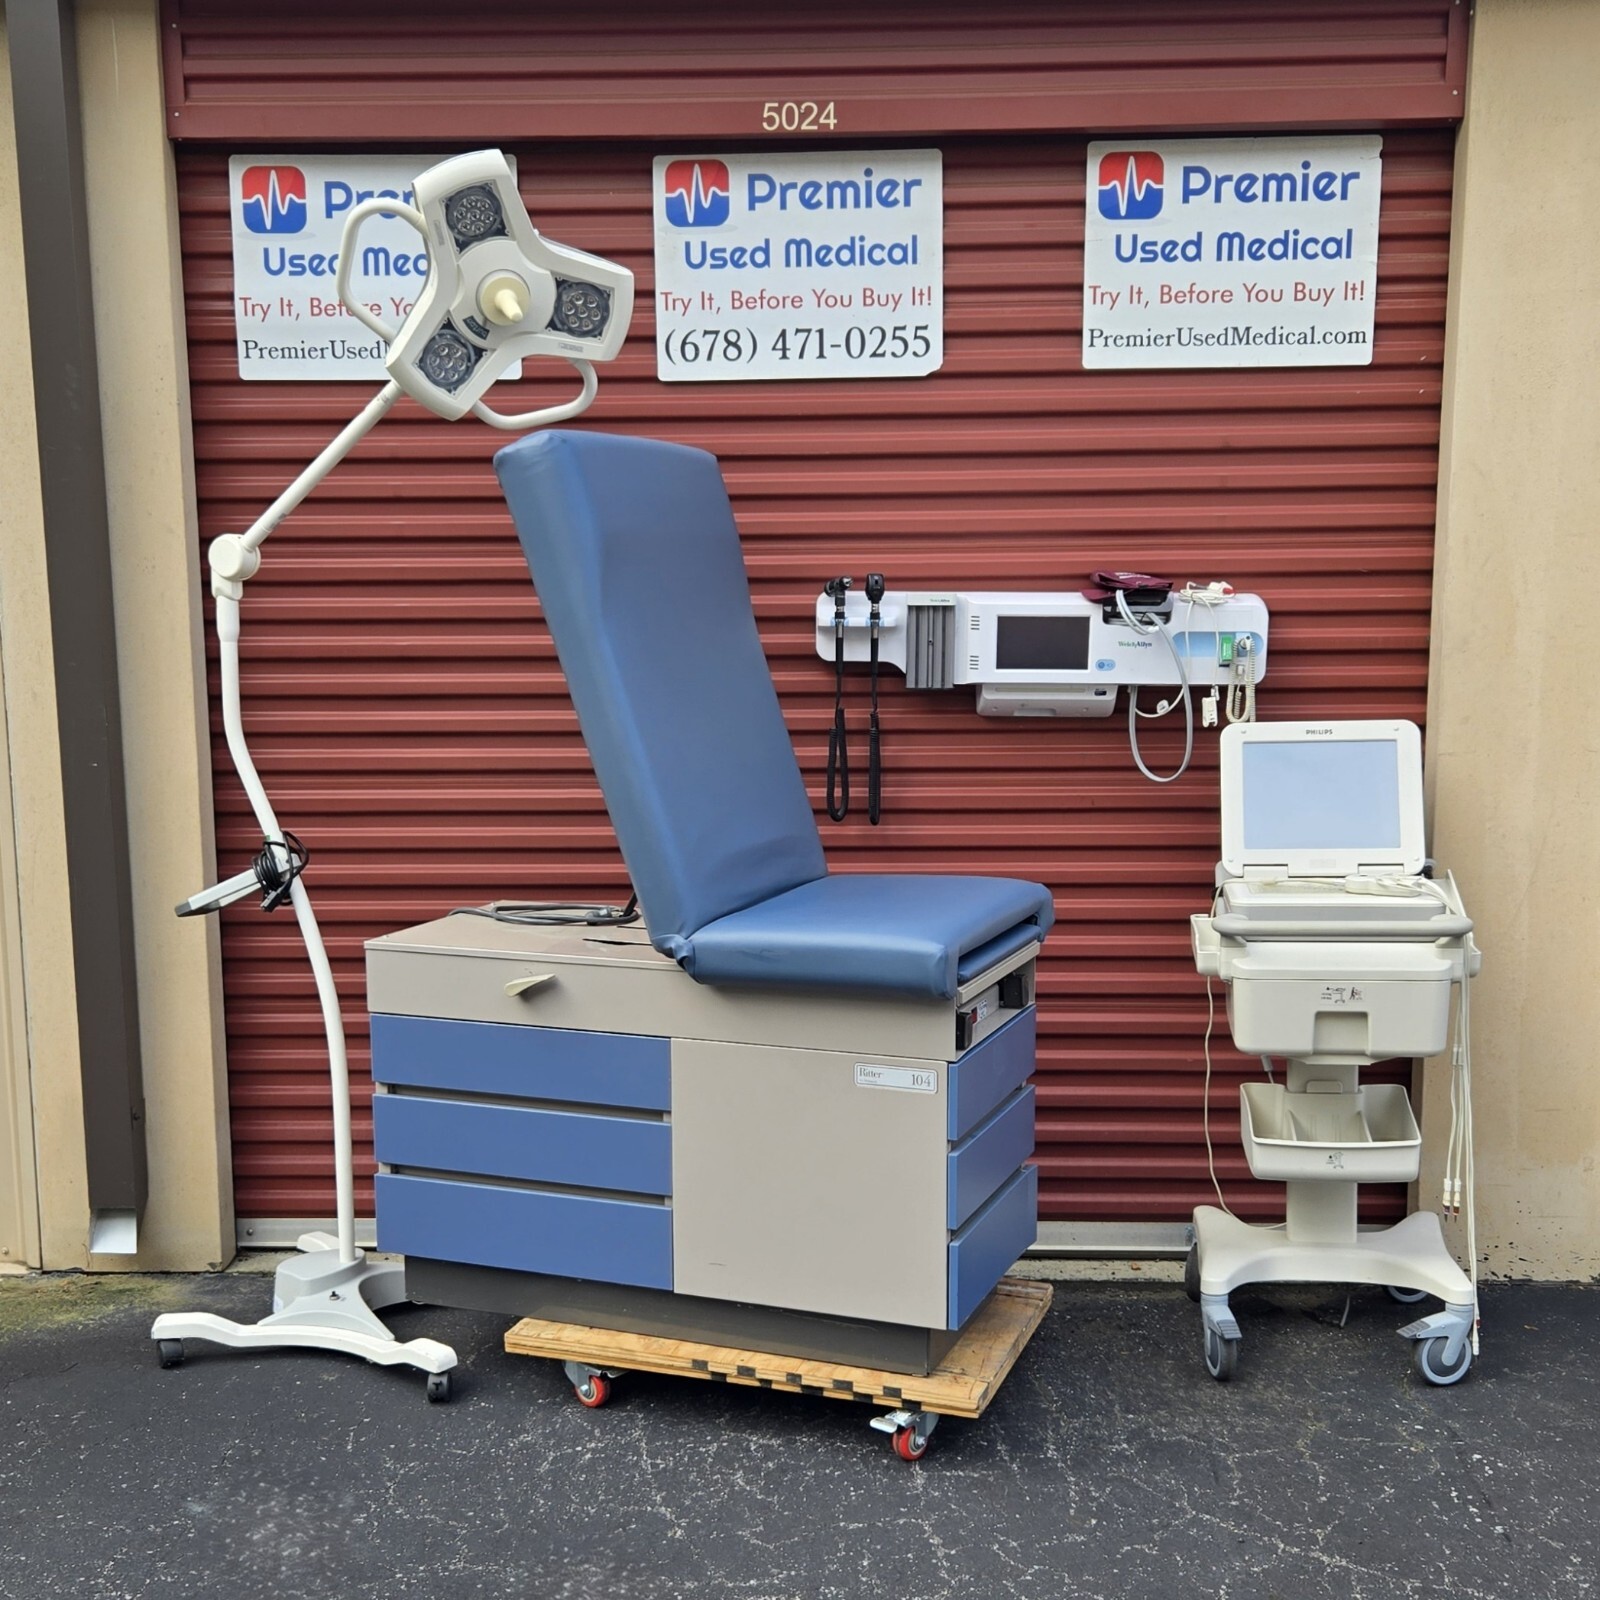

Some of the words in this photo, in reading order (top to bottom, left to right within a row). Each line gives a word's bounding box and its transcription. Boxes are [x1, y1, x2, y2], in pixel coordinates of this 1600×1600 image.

[762, 102, 838, 131] 5024
[748, 168, 922, 211] Premier
[1181, 160, 1361, 204] Premier
[685, 238, 770, 269] Used
[785, 235, 918, 268] Medical
[1115, 231, 1202, 263] Used
[1216, 229, 1353, 262] Medical
[239, 297, 271, 322] Try
[280, 297, 300, 321] It,
[660, 291, 692, 317] Try
[701, 291, 721, 314] It,
[731, 289, 803, 310] Before
[812, 288, 852, 308] You
[863, 288, 903, 312] Buy
[912, 286, 932, 306] It!
[1088, 285, 1121, 310] Try
[1129, 285, 1149, 308] It,
[1159, 282, 1233, 304] Before
[1242, 282, 1283, 303] You
[1294, 282, 1335, 307] Buy
[1344, 280, 1365, 301] It!
[665, 327, 758, 365] (678)
[771, 325, 931, 360] 471-0255
[1088, 326, 1367, 348] PremierUsedMedical.com
[911, 1073, 931, 1088] 104
